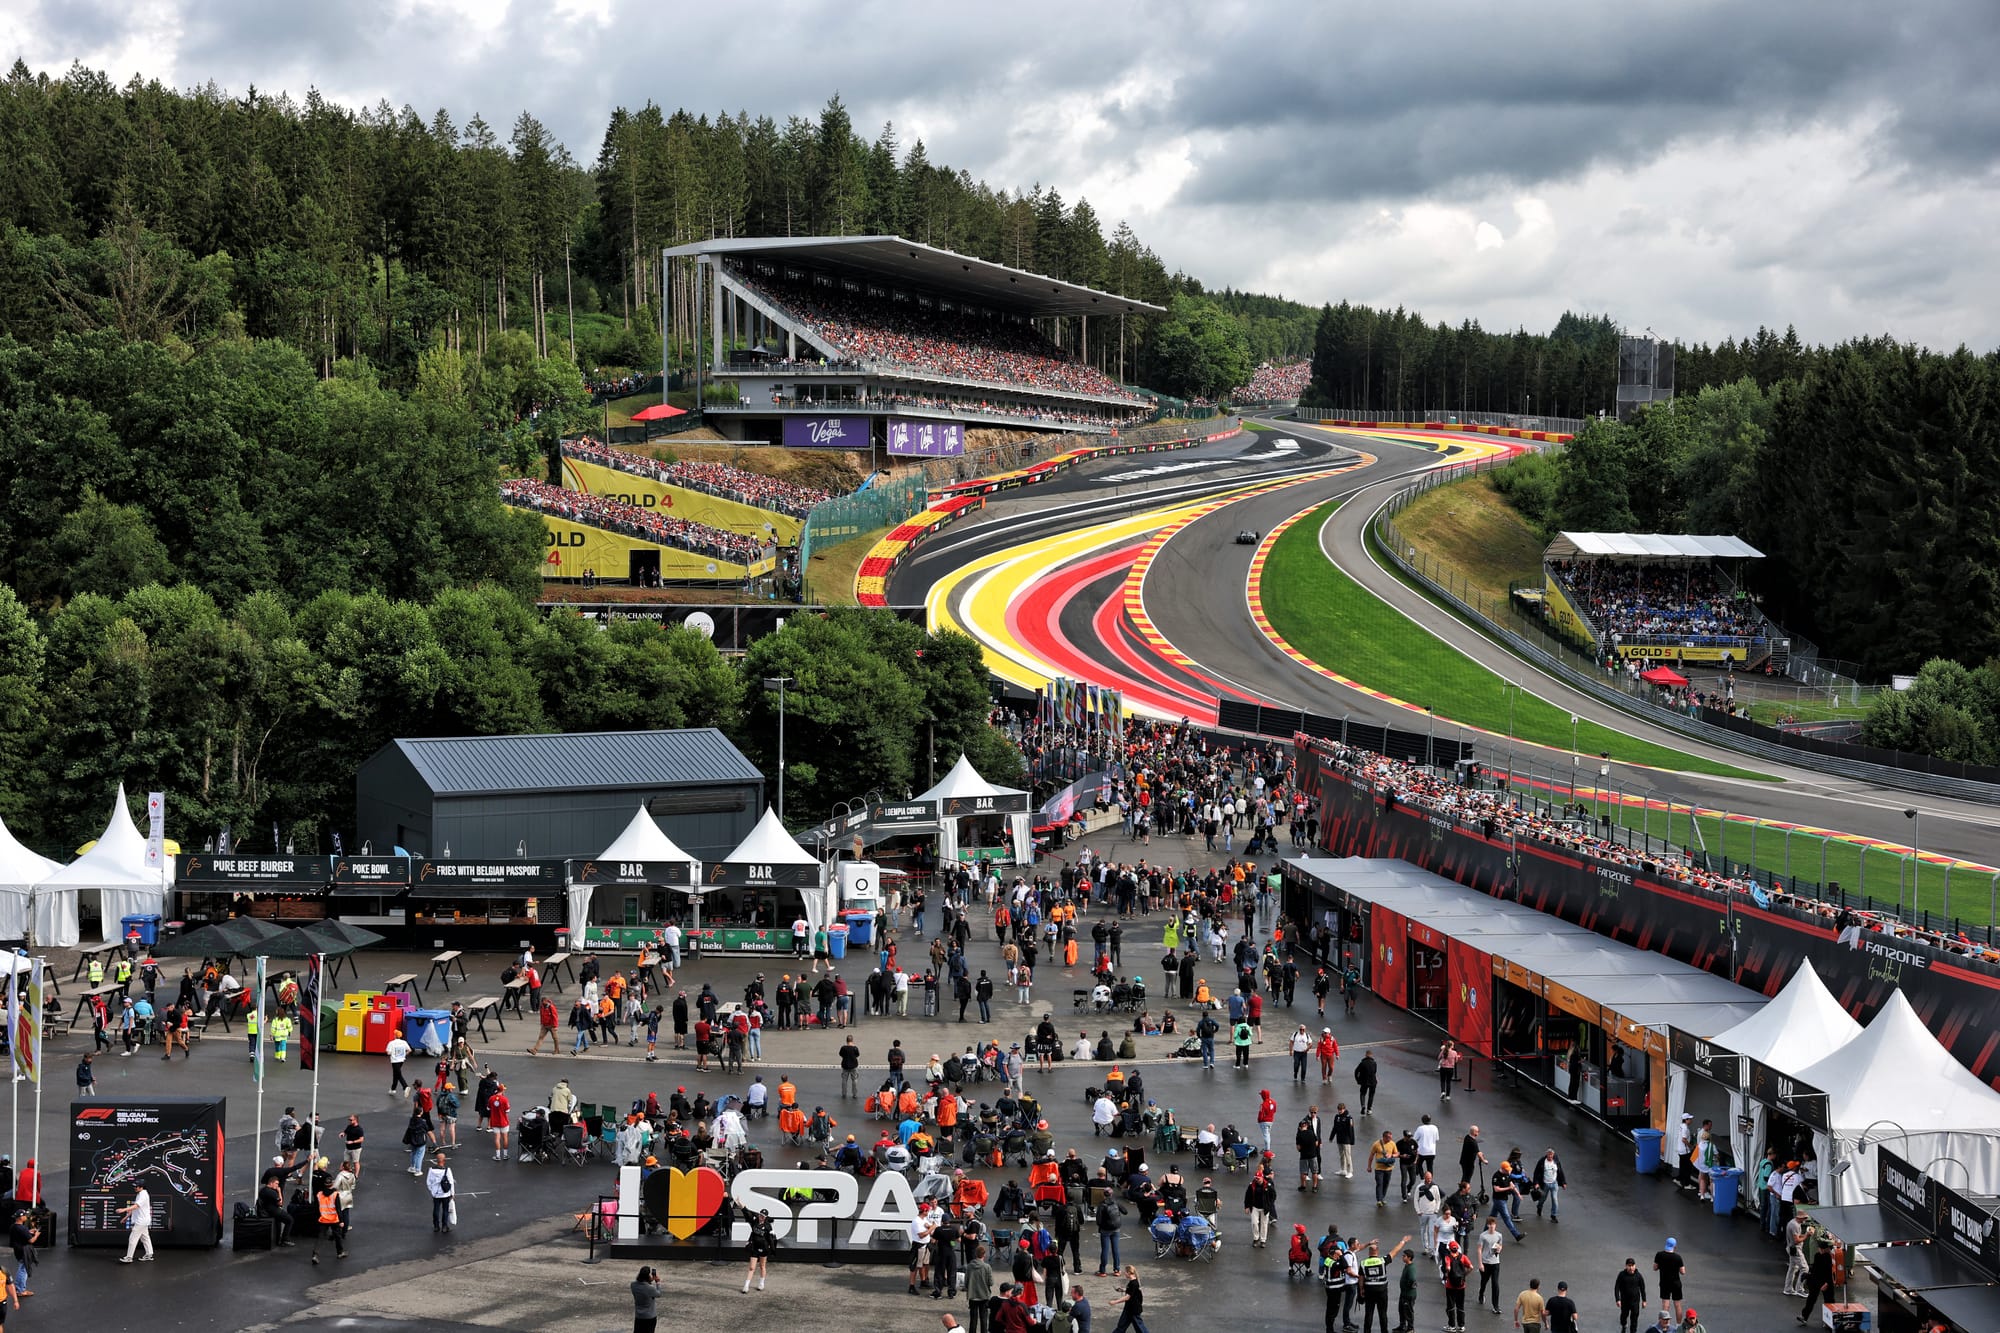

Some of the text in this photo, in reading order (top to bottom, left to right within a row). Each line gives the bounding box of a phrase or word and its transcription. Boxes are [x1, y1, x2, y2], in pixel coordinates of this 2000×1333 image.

[807, 420, 847, 444] Vegas
[660, 494, 674, 508] 4
[546, 532, 586, 547] OLD
[547, 550, 562, 566] 4
[627, 612, 663, 620] CHANDON
[1630, 647, 1672, 657] GOLD 5
[976, 797, 994, 809] BAR
[213, 860, 294, 873] PURE BEEF BURGER
[352, 863, 390, 875] POKE BOWL
[436, 865, 541, 876] FRIES WITH BELGIAN PASSPORT
[620, 863, 644, 877] BAR
[749, 865, 773, 879] BAR
[1596, 866, 1632, 885] FANZONE
[1719, 919, 1726, 934] F
[1735, 918, 1742, 934] E
[1864, 940, 1926, 970] FANZONE
[1777, 1075, 1794, 1105] BAR
[731, 1168, 919, 1244] SPA
[1951, 1205, 1966, 1235] MEAT
[1966, 1216, 1983, 1246] BUNS
